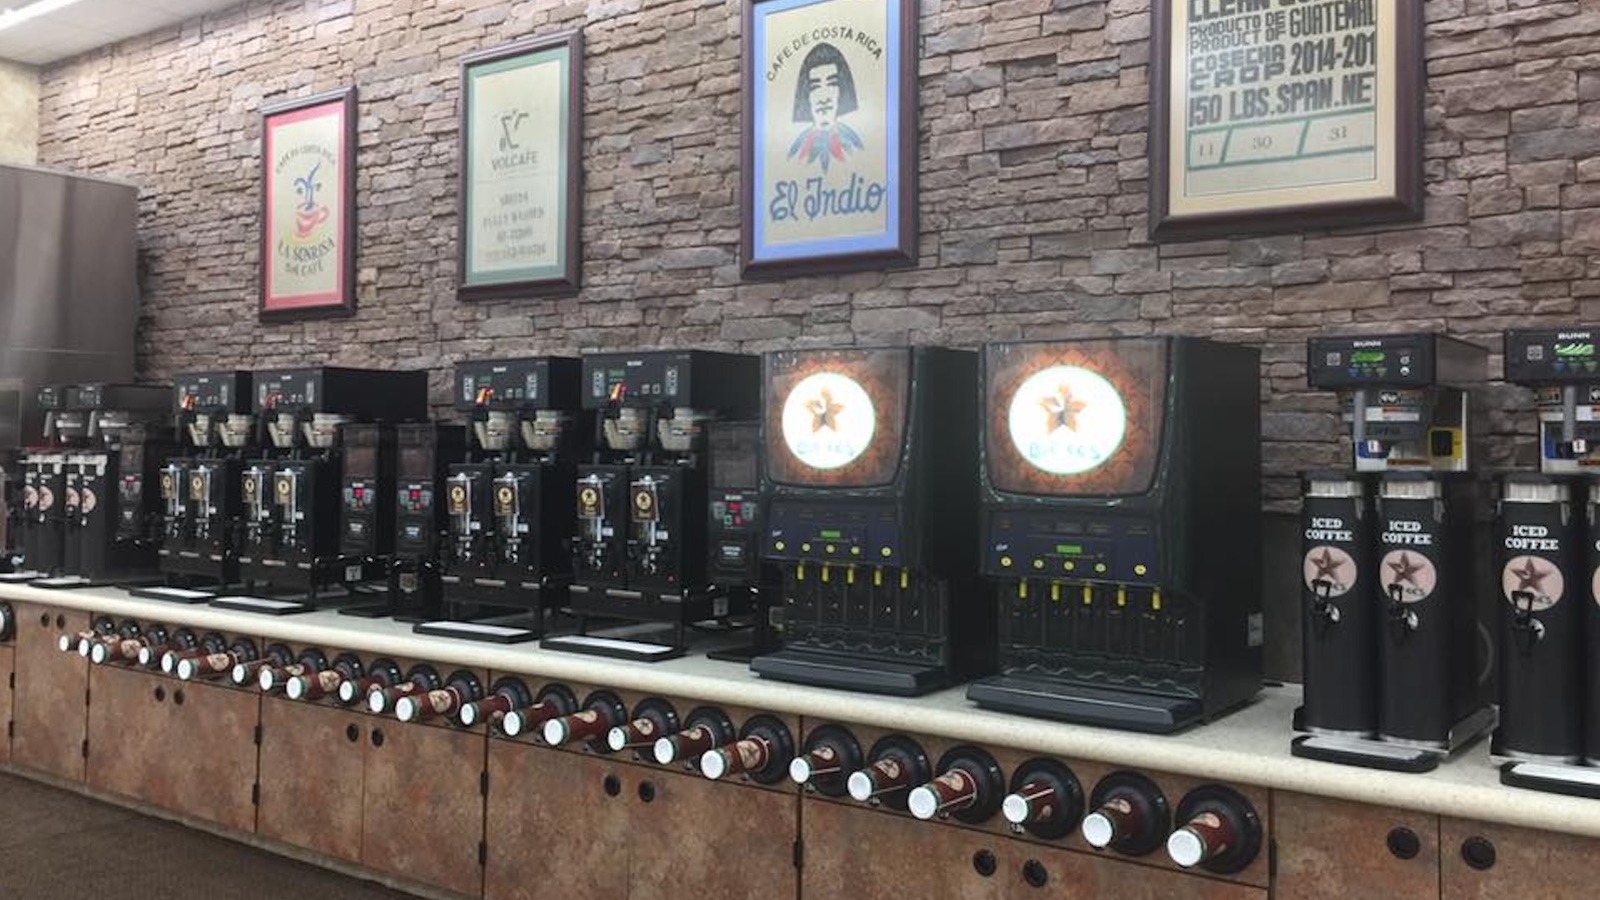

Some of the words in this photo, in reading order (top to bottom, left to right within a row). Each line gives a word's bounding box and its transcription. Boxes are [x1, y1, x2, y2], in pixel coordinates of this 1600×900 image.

[1189, 14, 1261, 38] PRODUCTO
[1265, 10, 1286, 28] DE
[767, 46, 792, 82] CAFE
[793, 33, 808, 52] DE
[812, 26, 853, 41] COSTA
[855, 32, 883, 60] RICA
[1190, 29, 1261, 55] PRODUCT
[1265, 26, 1287, 42] OF
[1190, 44, 1286, 74] COSECHA
[1190, 62, 1286, 92] CROP
[1189, 94, 1222, 126] 150
[769, 180, 799, 221] El
[803, 172, 887, 222] Indio
[1304, 529, 1353, 541] COFFEE
[1311, 517, 1343, 529] ICED
[1389, 520, 1422, 532] ICED
[1512, 525, 1549, 537] ICED
[1381, 532, 1433, 545] COFFEE
[1504, 537, 1560, 550] COFFEE
